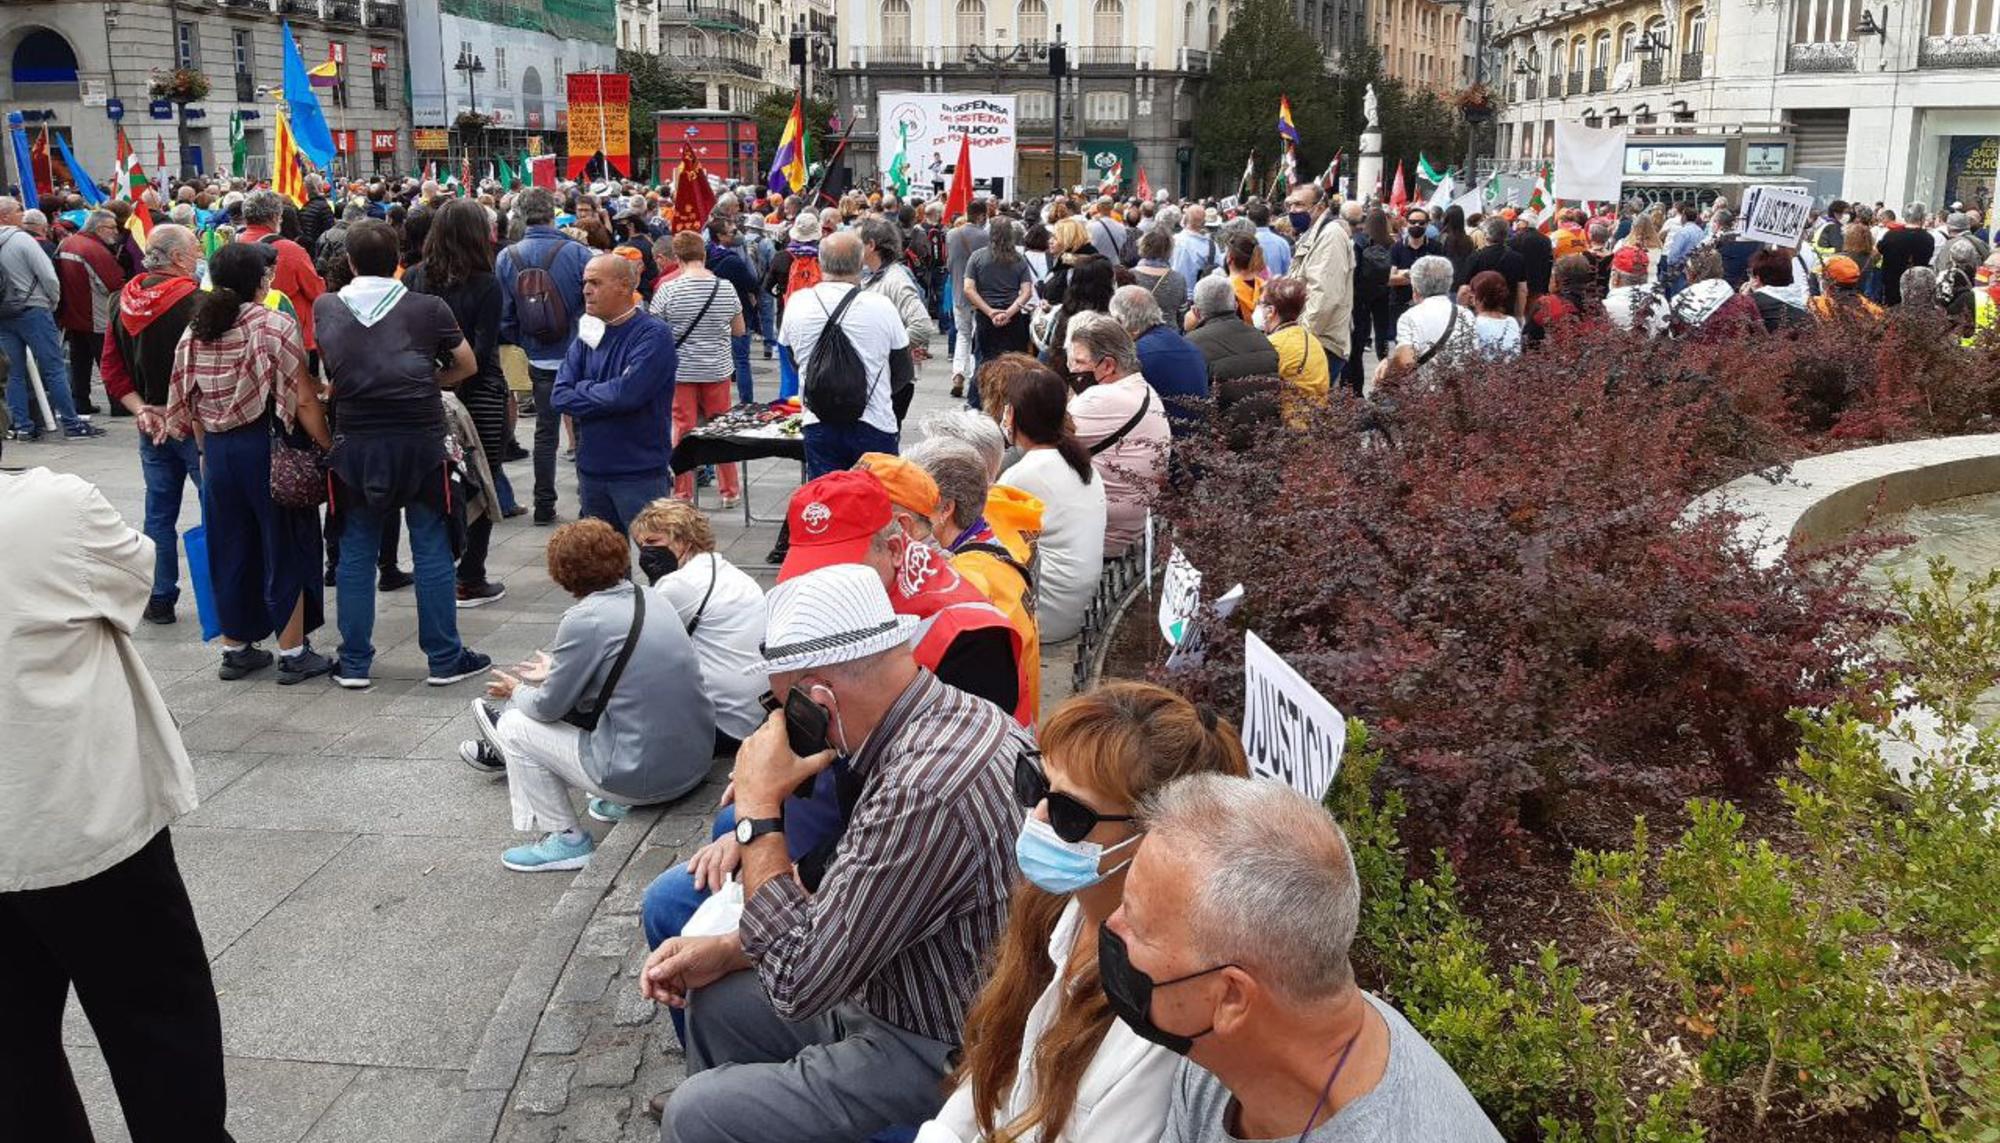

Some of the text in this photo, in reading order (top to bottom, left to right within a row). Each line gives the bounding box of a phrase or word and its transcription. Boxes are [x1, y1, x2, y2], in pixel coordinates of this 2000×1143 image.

[371, 52, 387, 63] KFC
[953, 100, 1009, 116] DEFENSA
[954, 113, 1008, 124] SISTEMA
[376, 135, 394, 147] KFC
